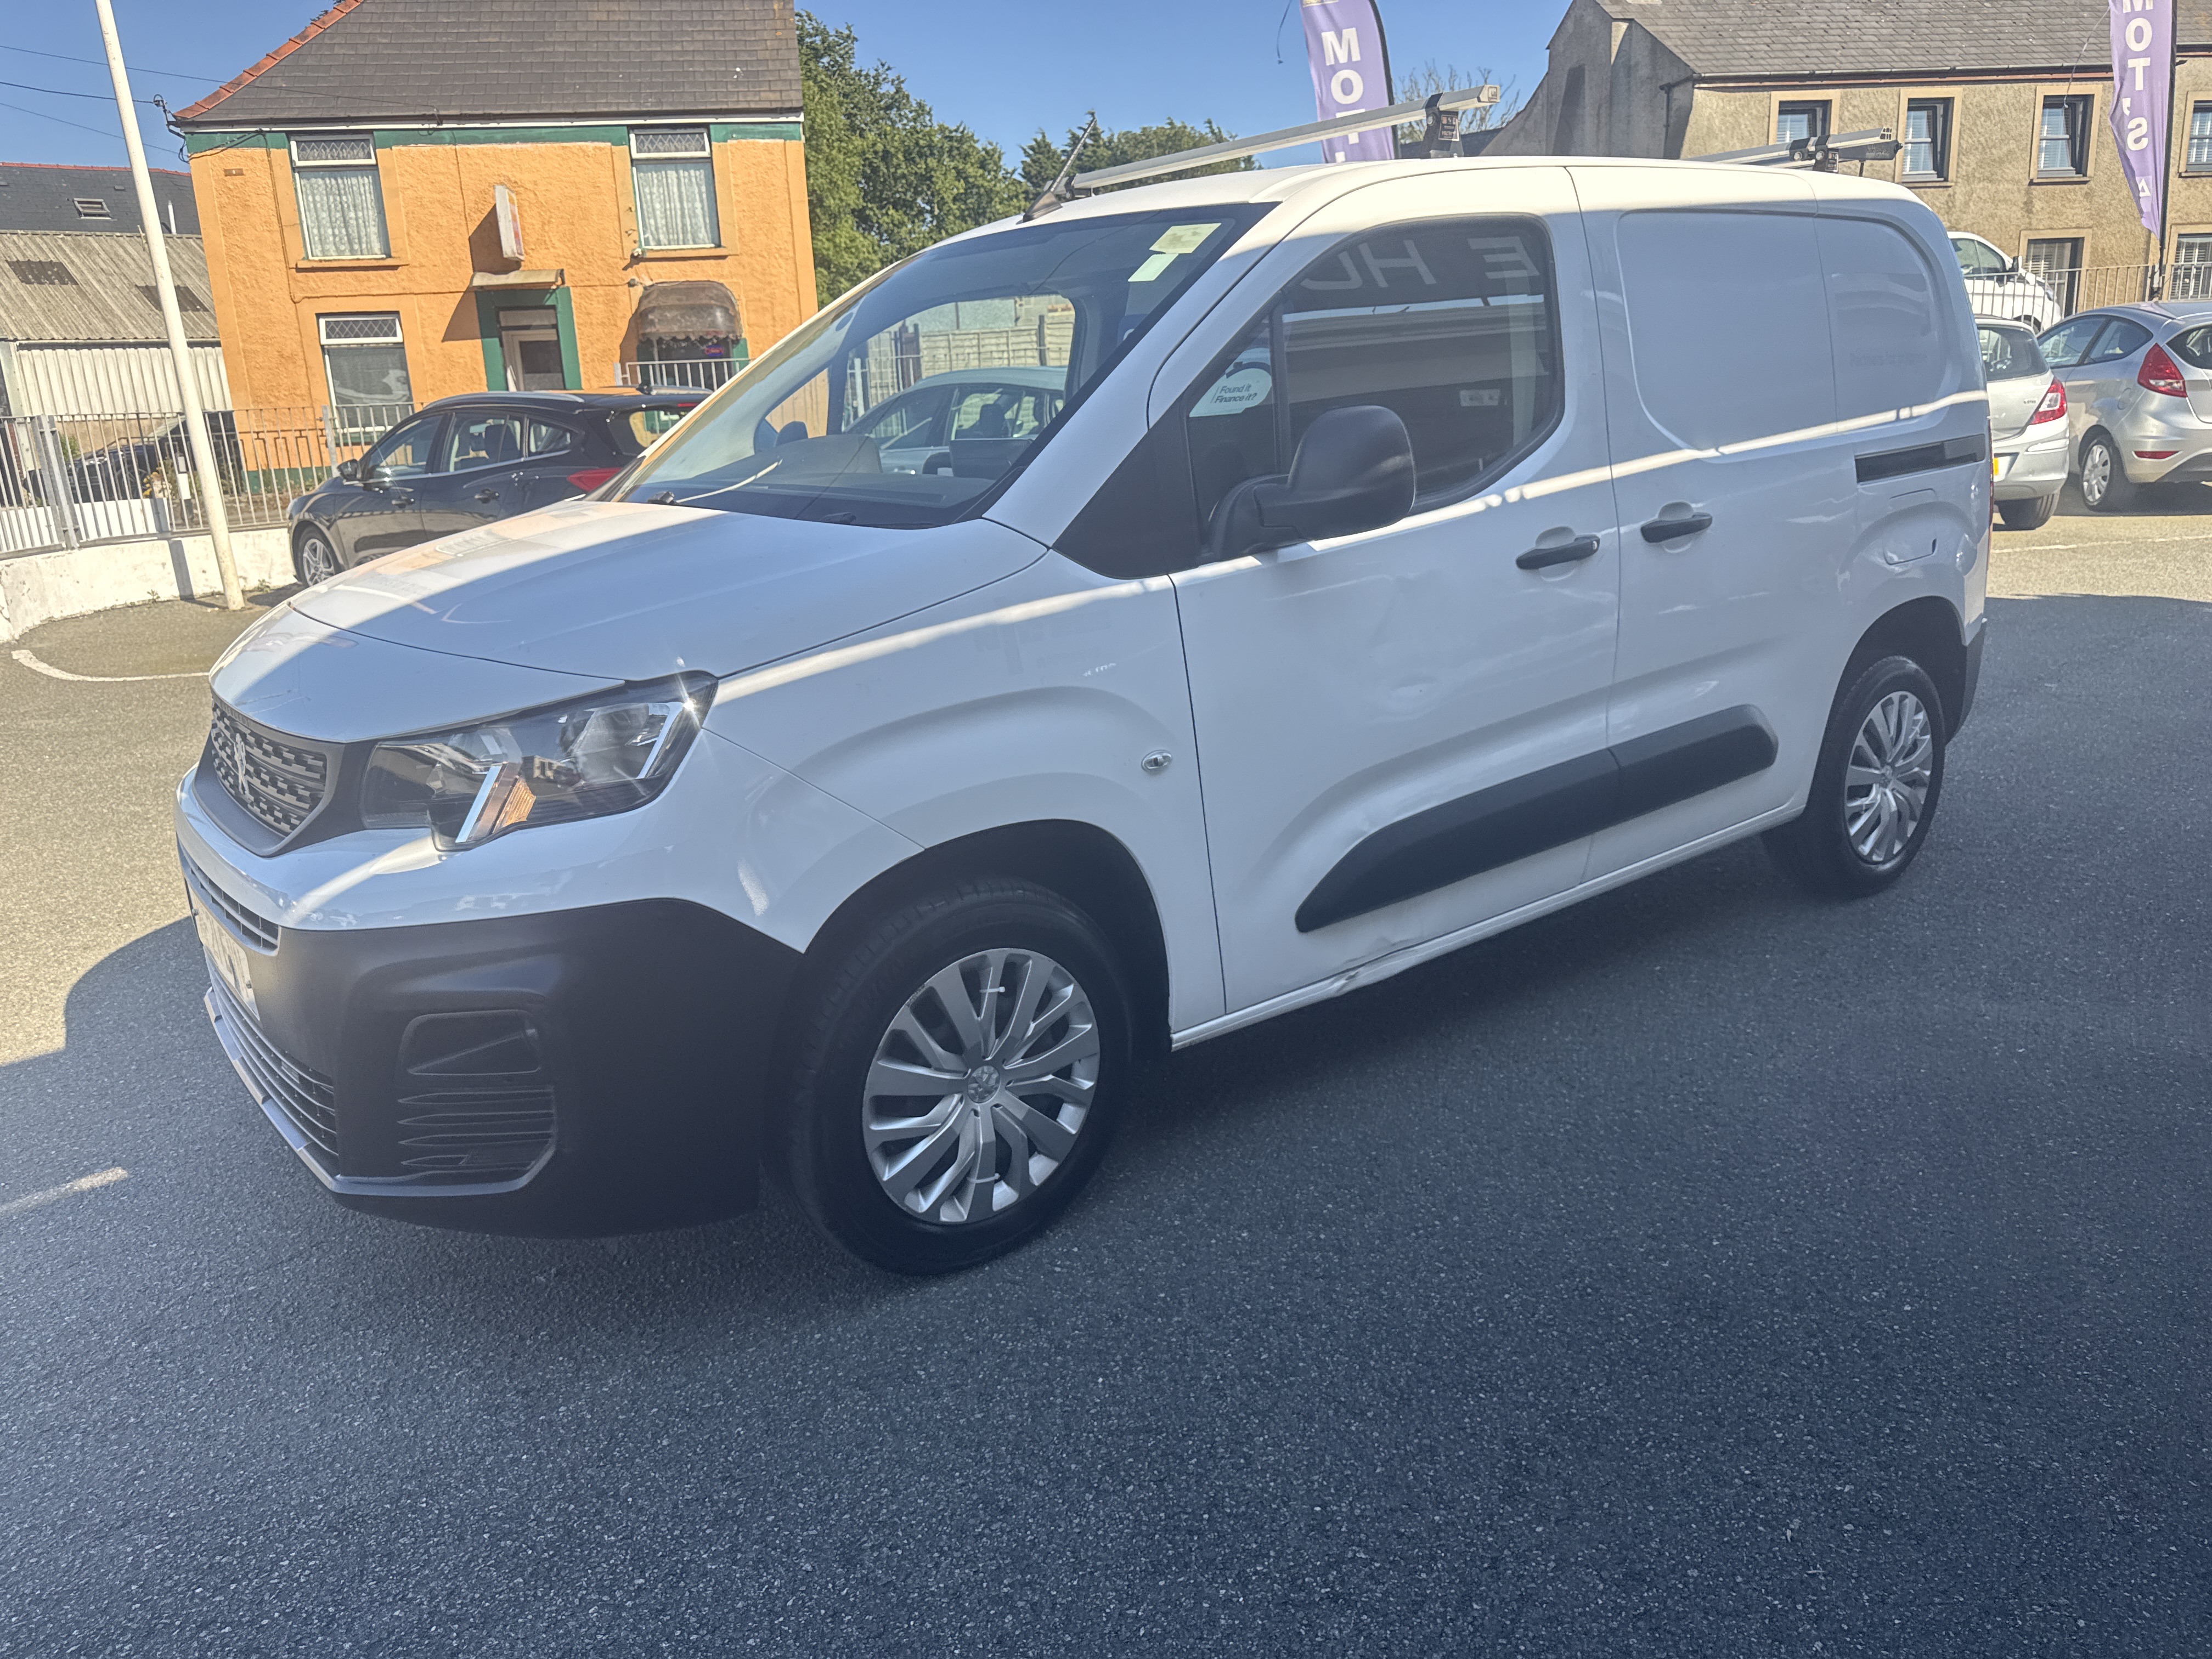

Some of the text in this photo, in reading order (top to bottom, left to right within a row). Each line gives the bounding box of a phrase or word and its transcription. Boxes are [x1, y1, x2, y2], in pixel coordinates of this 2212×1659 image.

[1219, 383, 1251, 394] Found it
[1214, 392, 1257, 403] Finance it?
